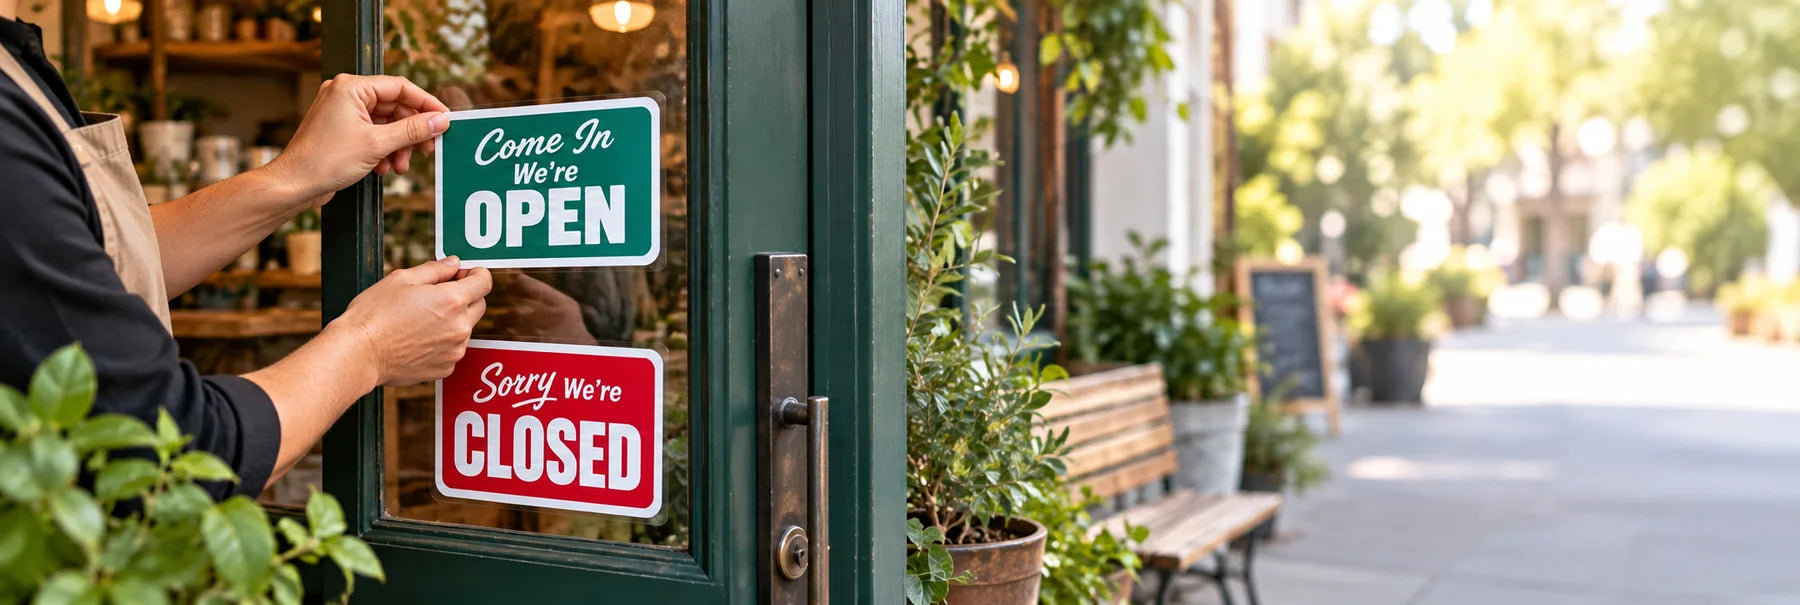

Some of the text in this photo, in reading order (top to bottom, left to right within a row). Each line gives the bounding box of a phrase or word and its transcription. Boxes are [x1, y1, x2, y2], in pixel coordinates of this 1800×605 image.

[475, 118, 615, 166] Come In
[514, 161, 578, 185] We're
[465, 185, 625, 248] OPEN
[473, 362, 622, 411] Sorry We're
[454, 411, 641, 491] CLOSED
